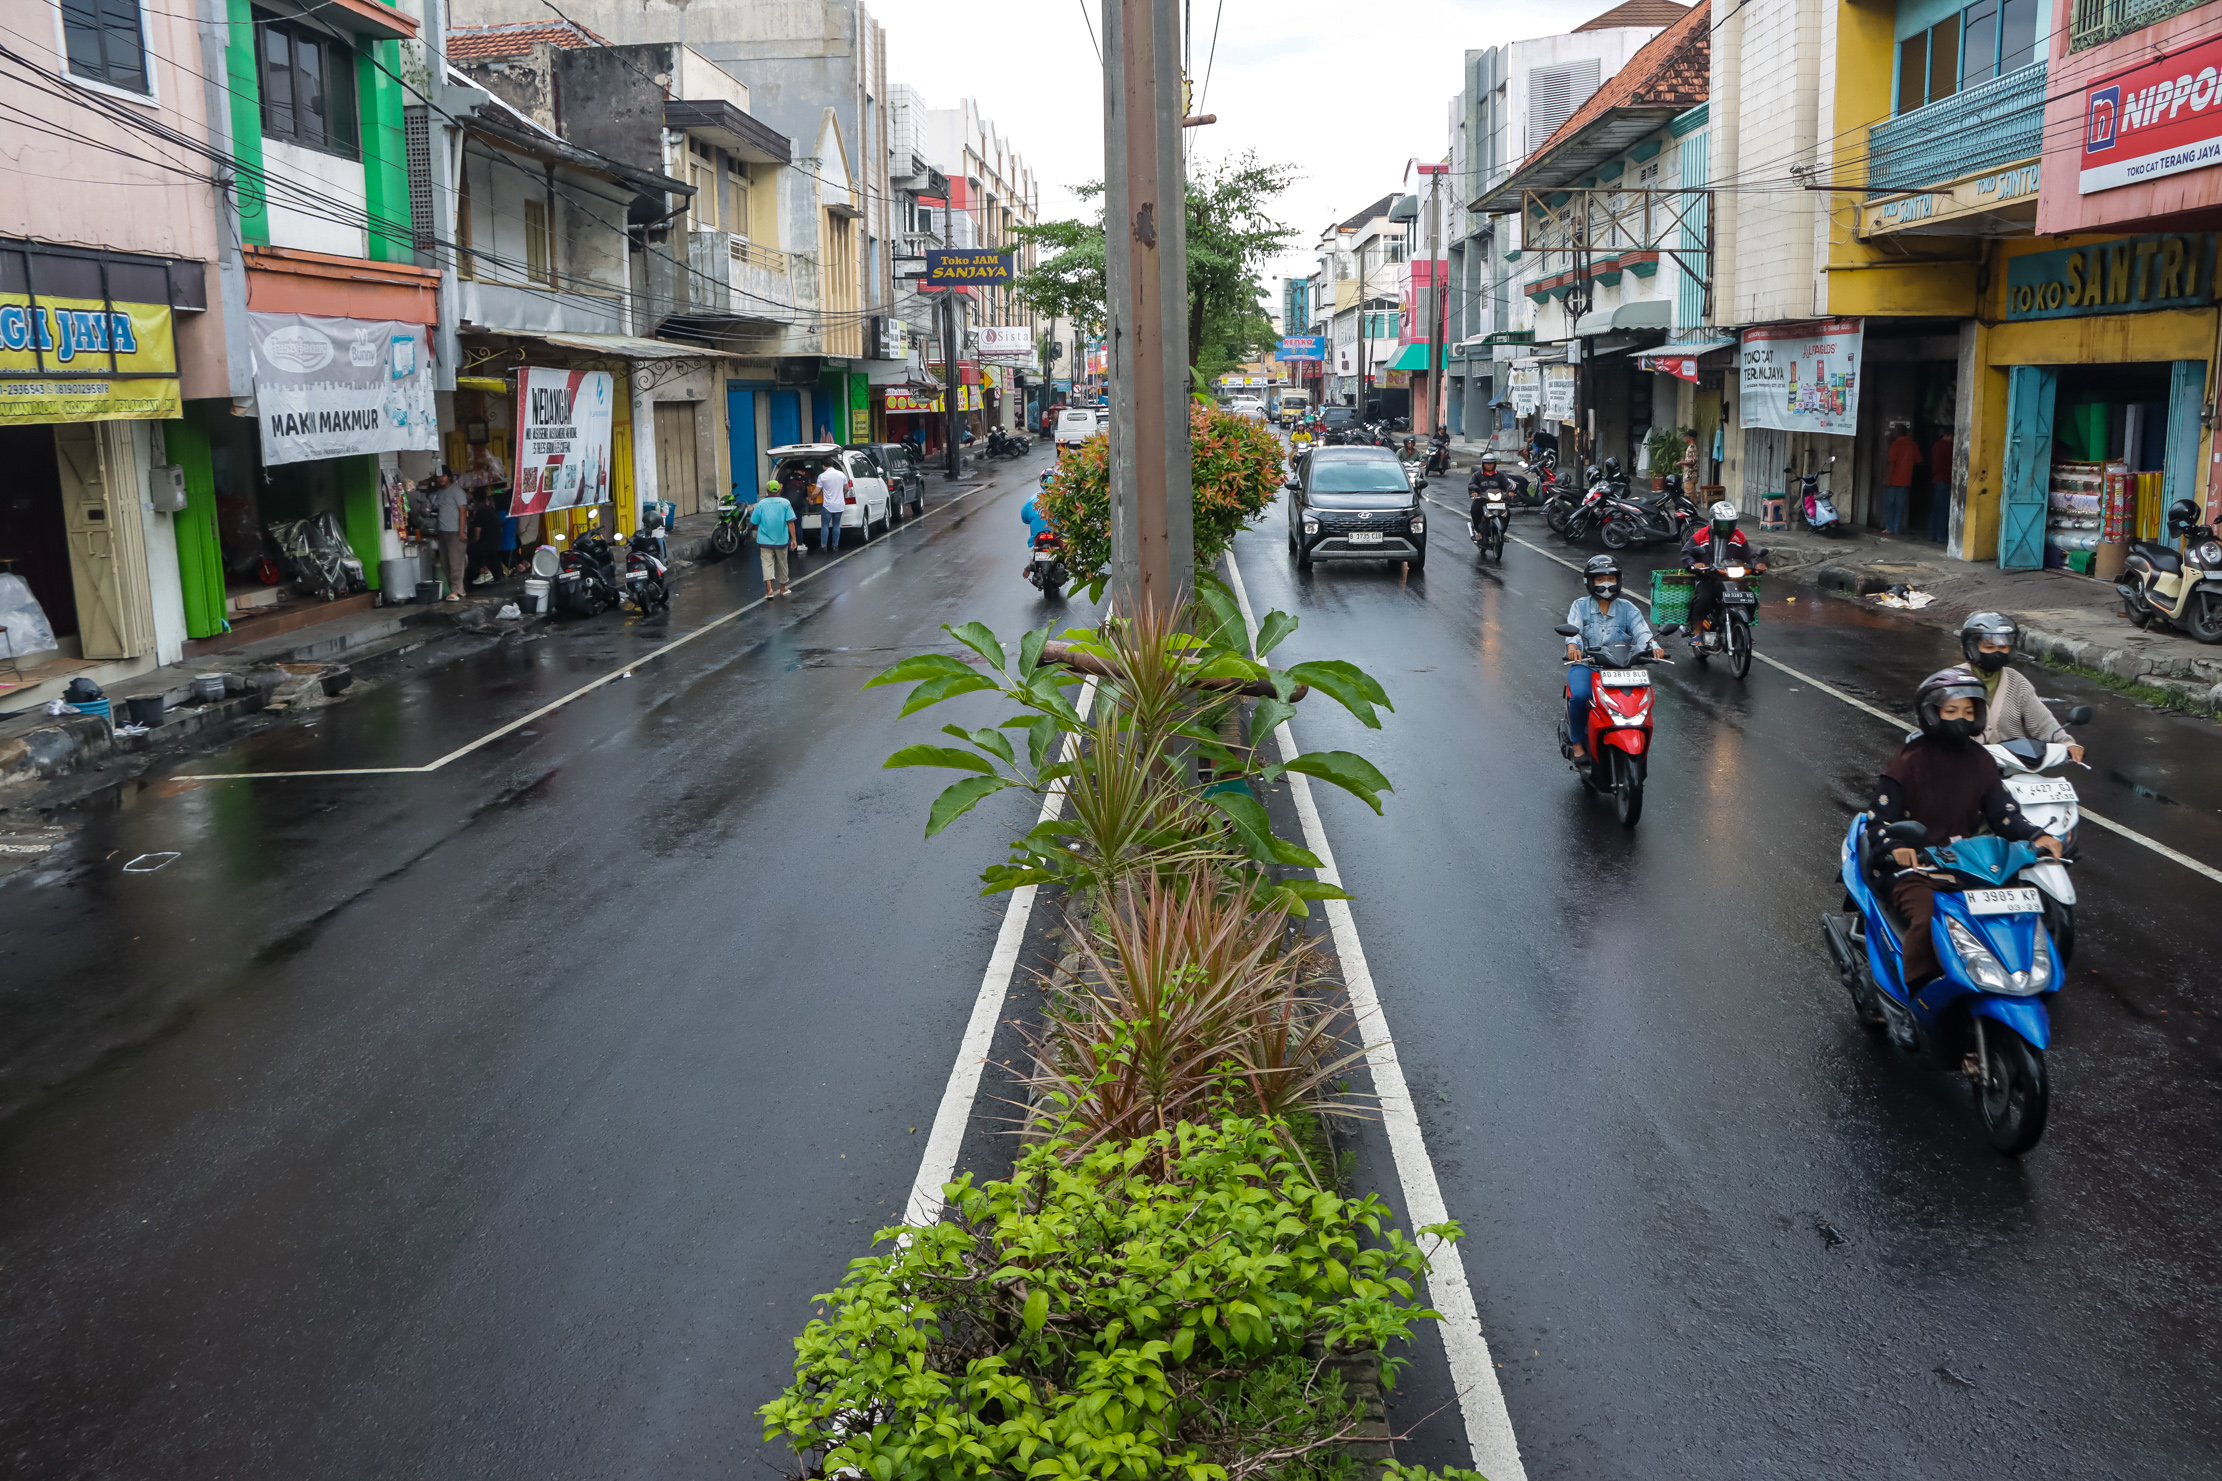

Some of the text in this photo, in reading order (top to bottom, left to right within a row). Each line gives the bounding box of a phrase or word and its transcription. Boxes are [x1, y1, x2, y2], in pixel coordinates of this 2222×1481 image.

[2127, 144, 2221, 177] TOKO CAT TERANG JAYA
[1976, 163, 2041, 200] TOKO SANTRI
[1882, 193, 1933, 222] TOKO SANTRI
[940, 255, 999, 265] Toko JAM
[932, 266, 1008, 279] SANJAYA
[2009, 234, 2203, 313] TOKO SANTRI
[54, 308, 137, 362] JAYA
[997, 330, 1029, 342] Sista
[351, 346, 375, 365] Bunny
[1743, 350, 1760, 366] TOKO
[1743, 367, 1768, 381] TERN
[532, 387, 573, 426] WEDANGAN
[319, 408, 379, 433] MAKMUR
[1966, 892, 1976, 903] H
[2020, 889, 2037, 901] KP
